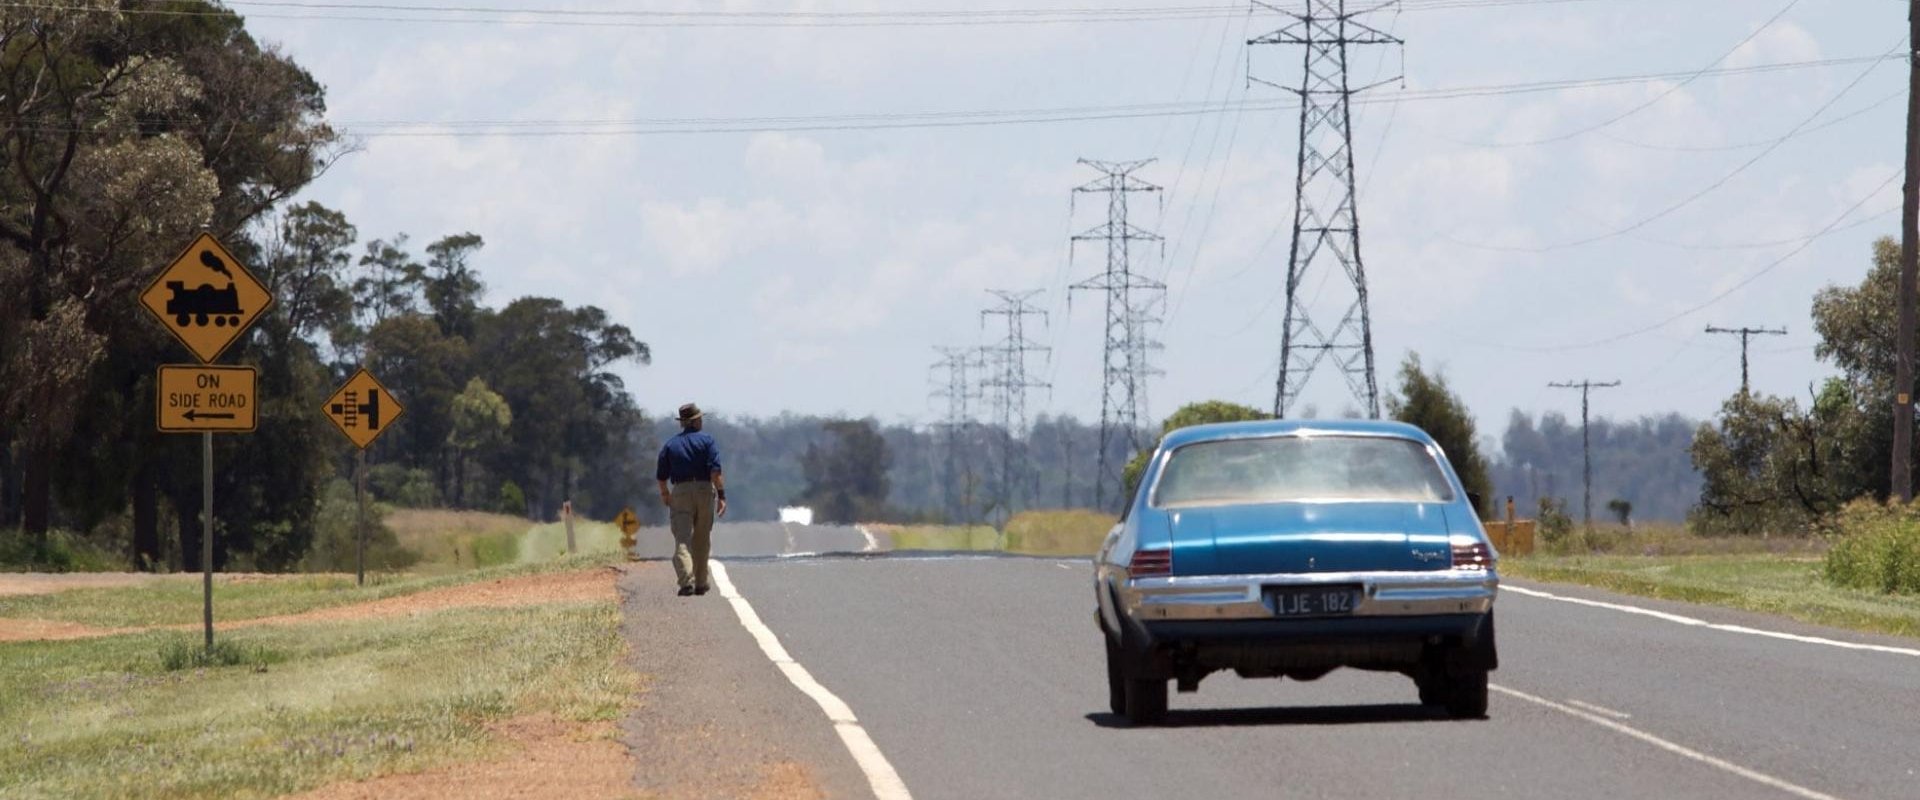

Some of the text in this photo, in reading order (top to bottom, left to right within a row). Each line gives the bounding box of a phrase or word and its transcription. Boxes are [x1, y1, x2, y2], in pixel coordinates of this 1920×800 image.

[197, 374, 219, 388] ON
[169, 393, 246, 408] SIDE ROAD
